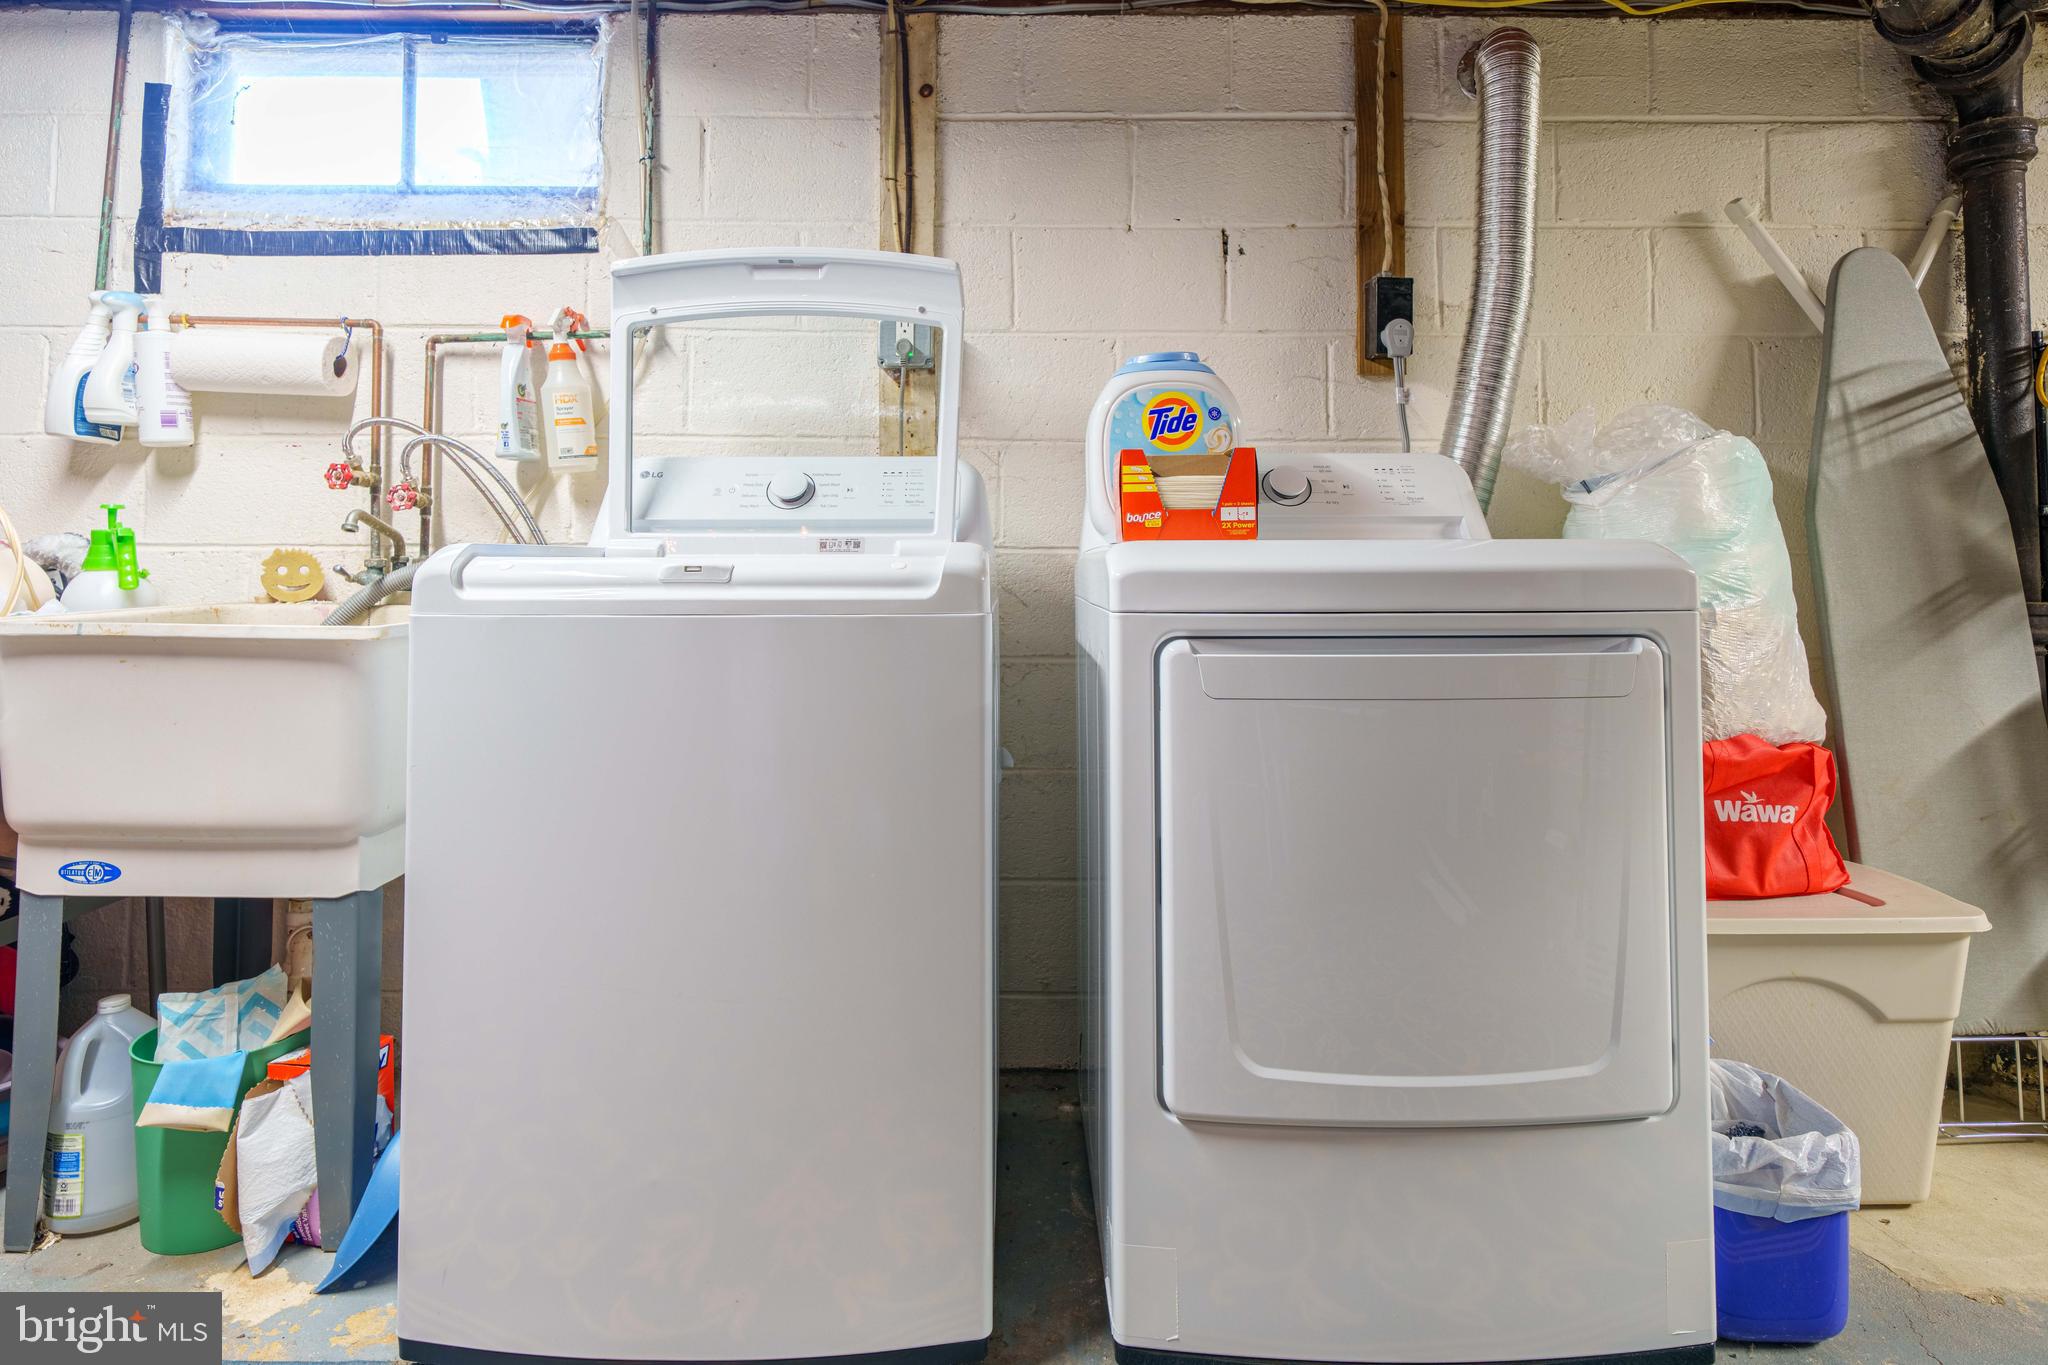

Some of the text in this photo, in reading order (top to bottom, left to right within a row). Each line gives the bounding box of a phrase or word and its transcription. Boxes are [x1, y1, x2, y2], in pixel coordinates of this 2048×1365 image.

[1148, 405, 1198, 441] Tide
[1126, 511, 1162, 523] bounce
[1222, 521, 1256, 529] 2X Power
[1714, 799, 1796, 824] Wawa
